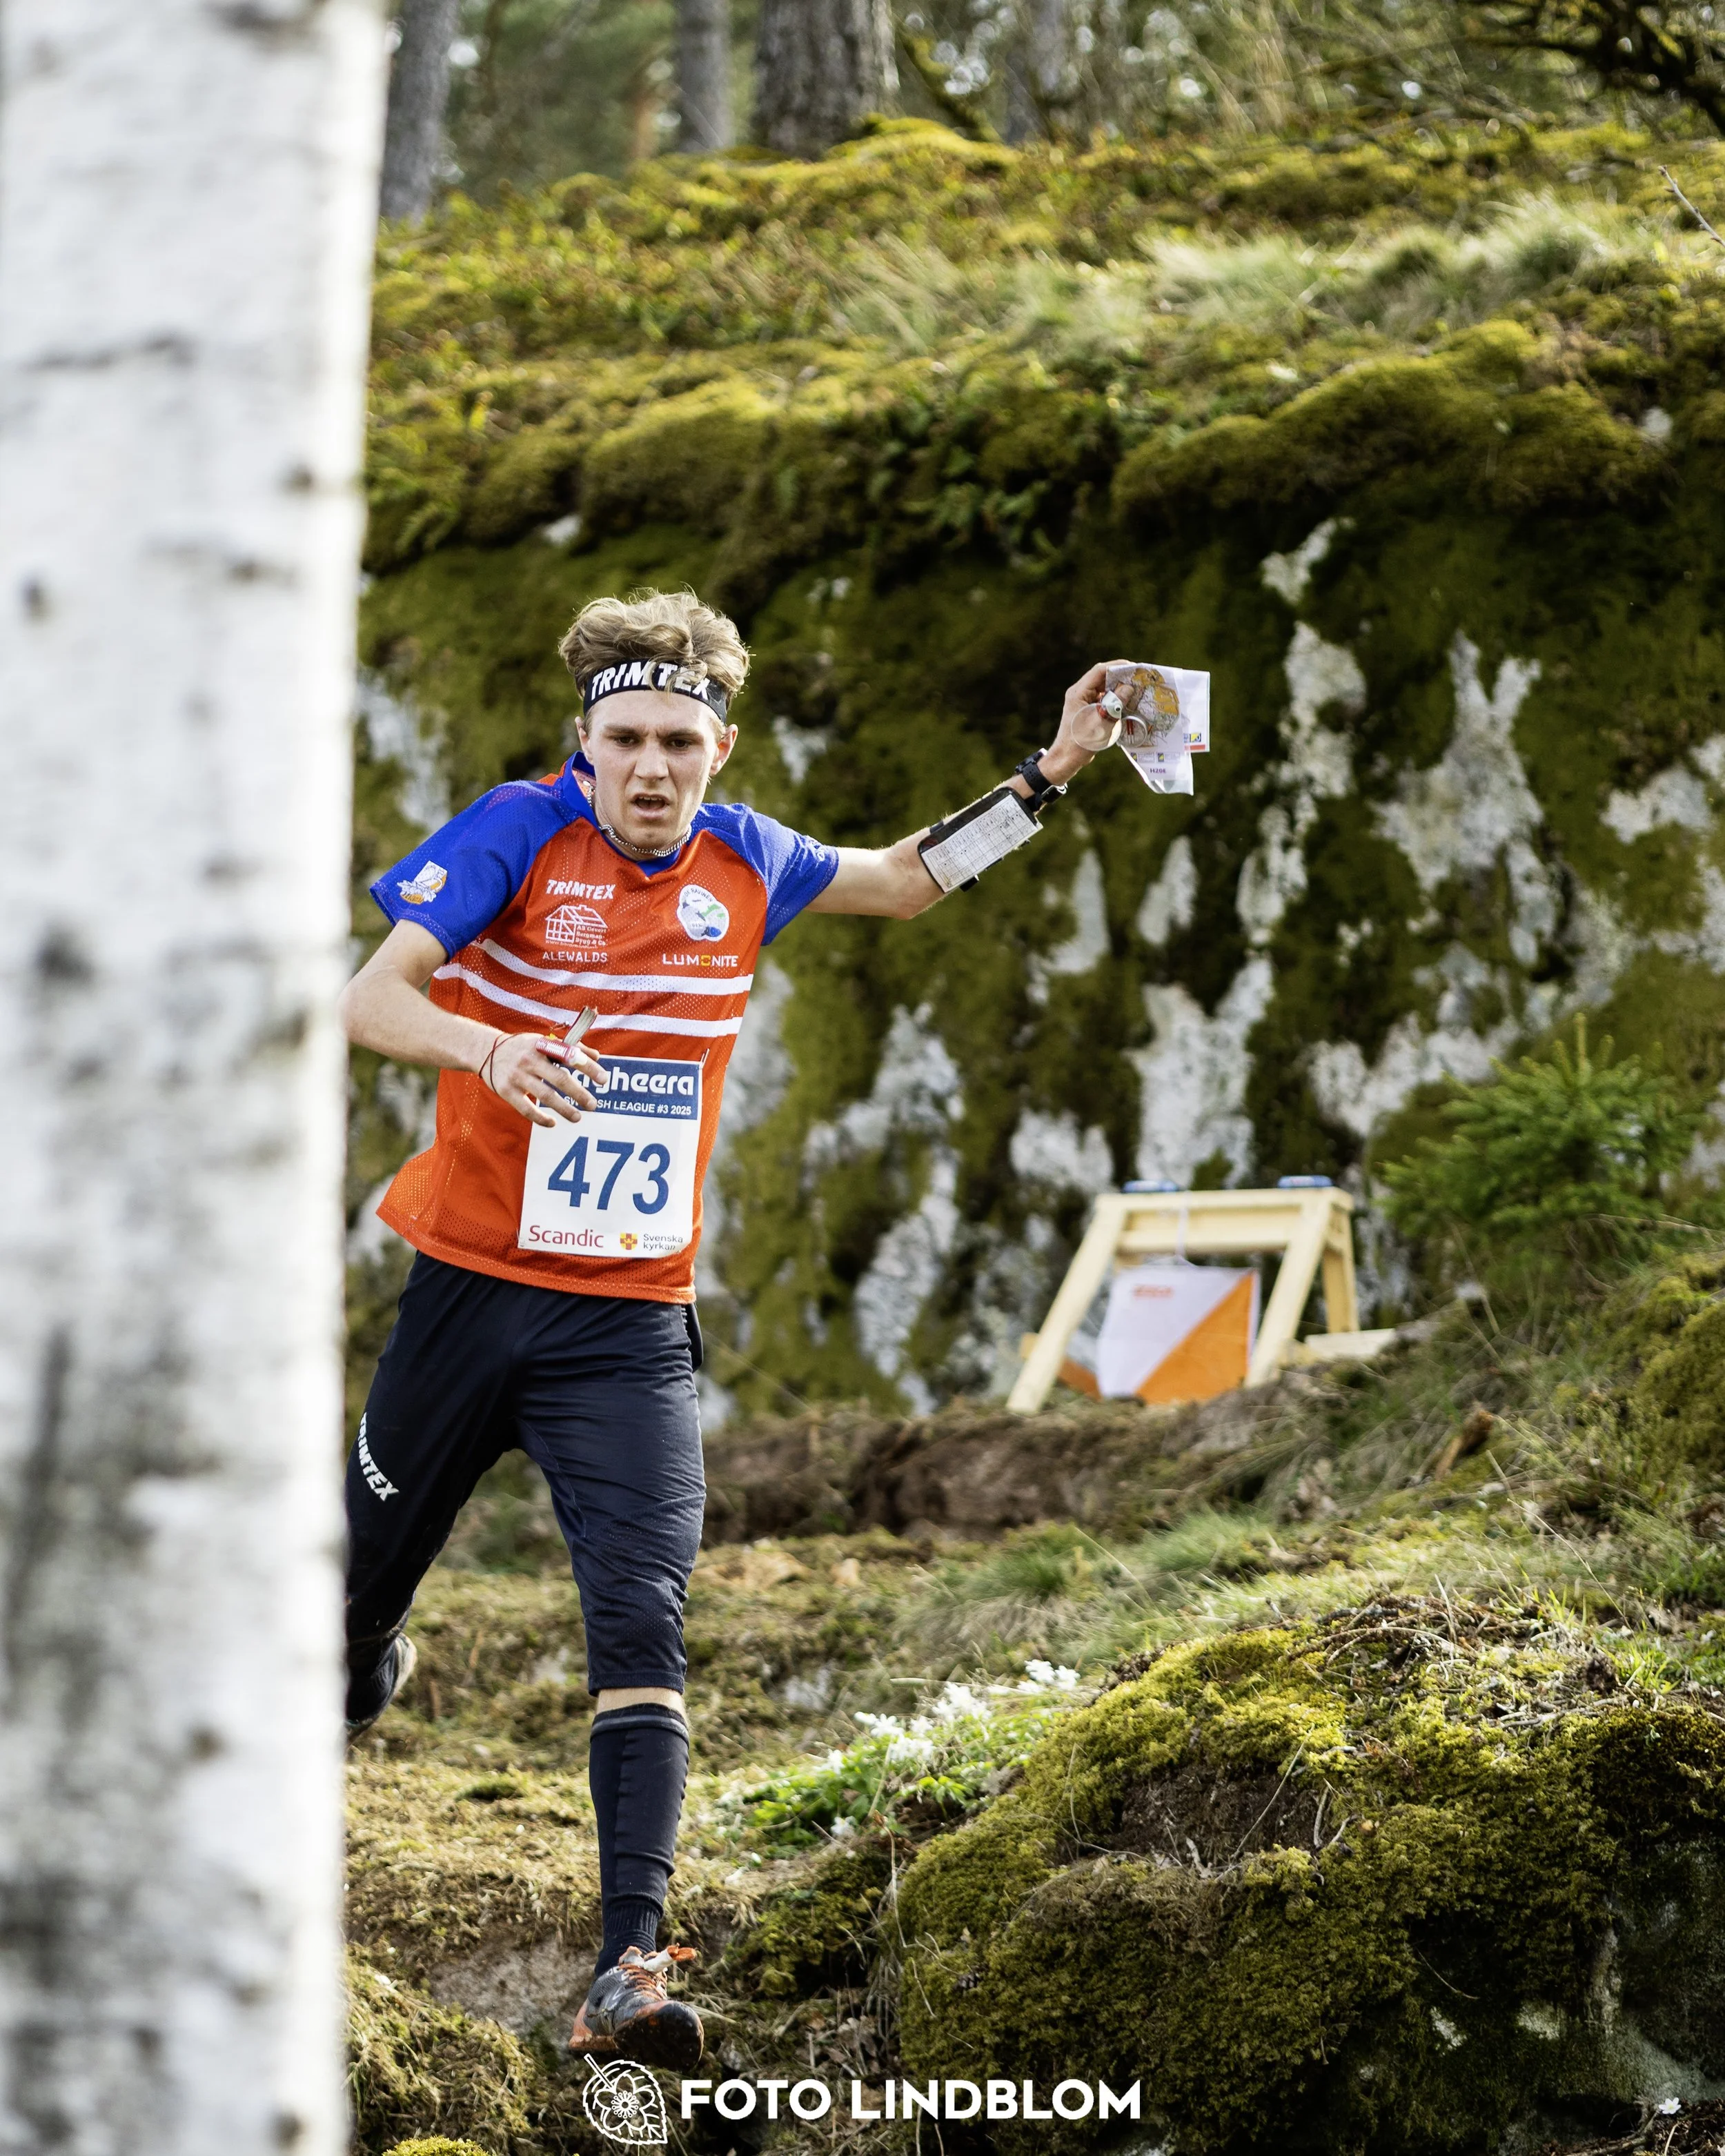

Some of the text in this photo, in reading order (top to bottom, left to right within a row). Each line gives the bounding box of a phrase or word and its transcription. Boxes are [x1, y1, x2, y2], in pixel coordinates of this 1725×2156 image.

[591, 661, 709, 701] TRIMTEX
[546, 879, 615, 900] TRIMTEX
[542, 951, 607, 962] ALEWALDS
[662, 953, 739, 967] LUMONITE
[613, 1100, 656, 1114] LEAGUE
[657, 1105, 669, 1114] #3
[670, 1105, 691, 1116] 2025
[547, 1136, 671, 1214] 473
[529, 1225, 604, 1248] Scandic
[643, 1234, 683, 1243] Svenska
[643, 1242, 676, 1251] kyrkan
